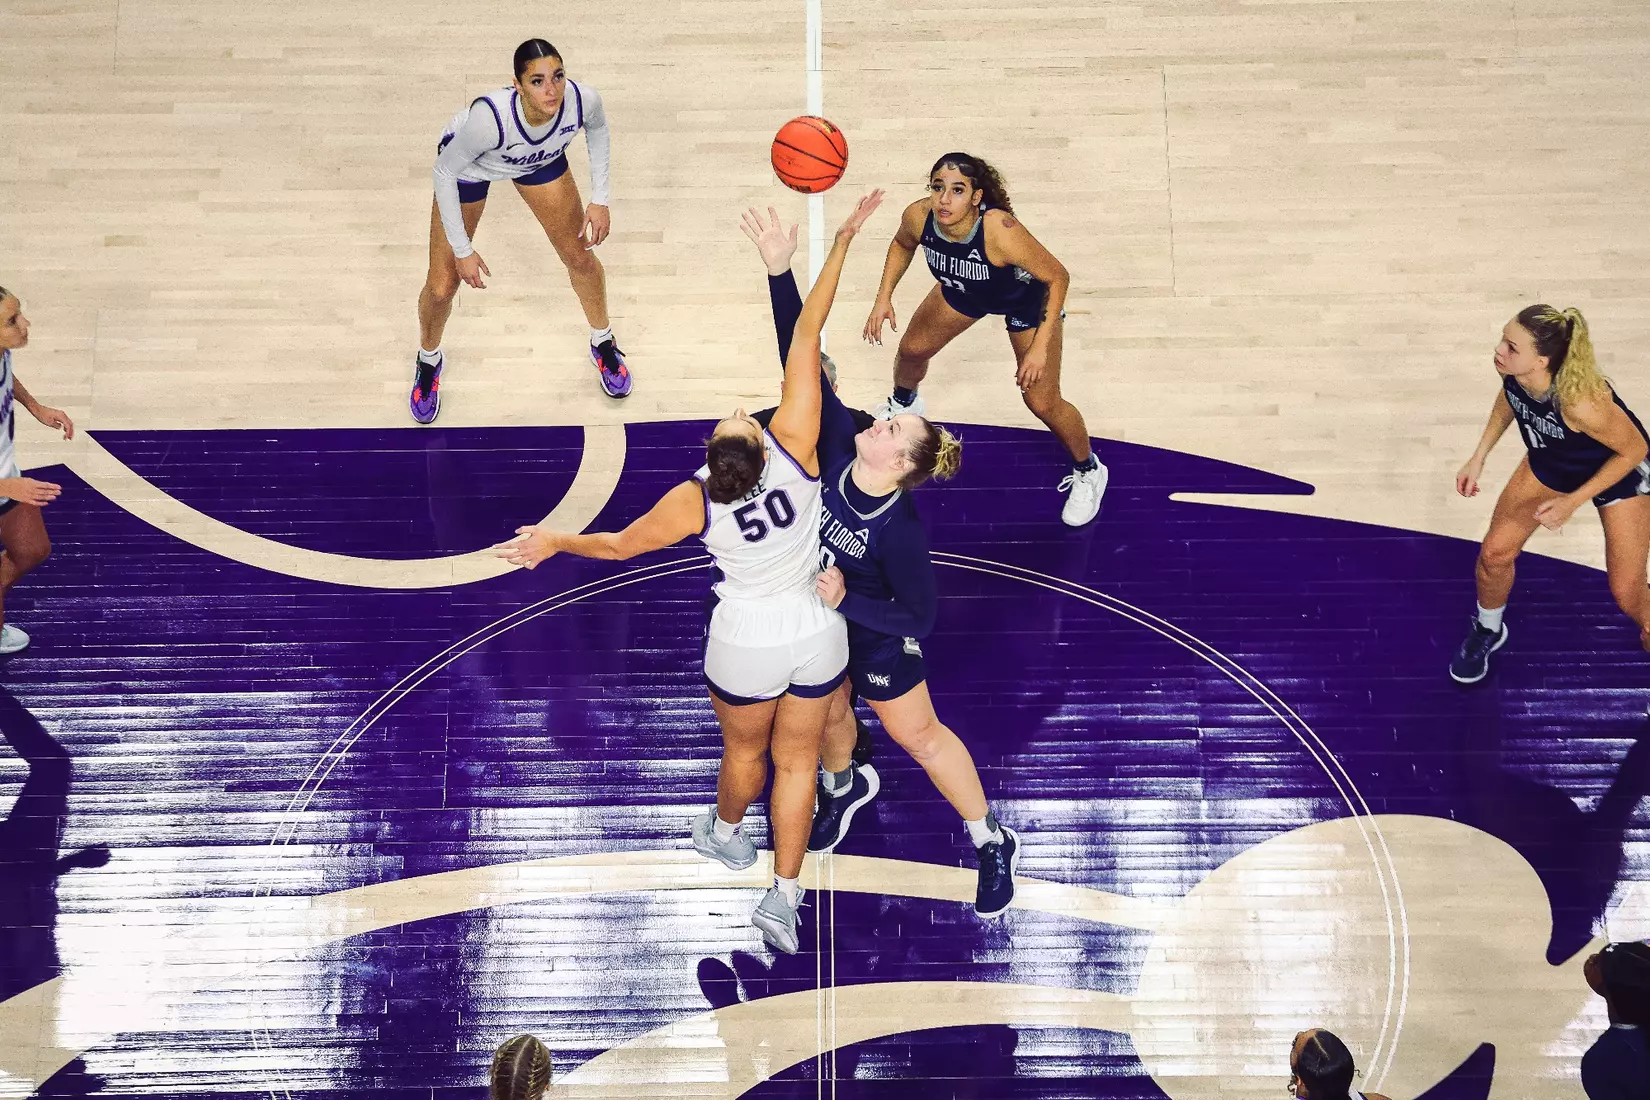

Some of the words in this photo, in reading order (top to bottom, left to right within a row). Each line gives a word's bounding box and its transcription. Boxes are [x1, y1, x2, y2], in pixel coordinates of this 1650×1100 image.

[501, 141, 570, 165] Wildcat
[949, 256, 990, 280] FLORIDA
[732, 488, 797, 543] 50
[824, 518, 866, 560] FLORIDA
[867, 673, 889, 687] UNF
